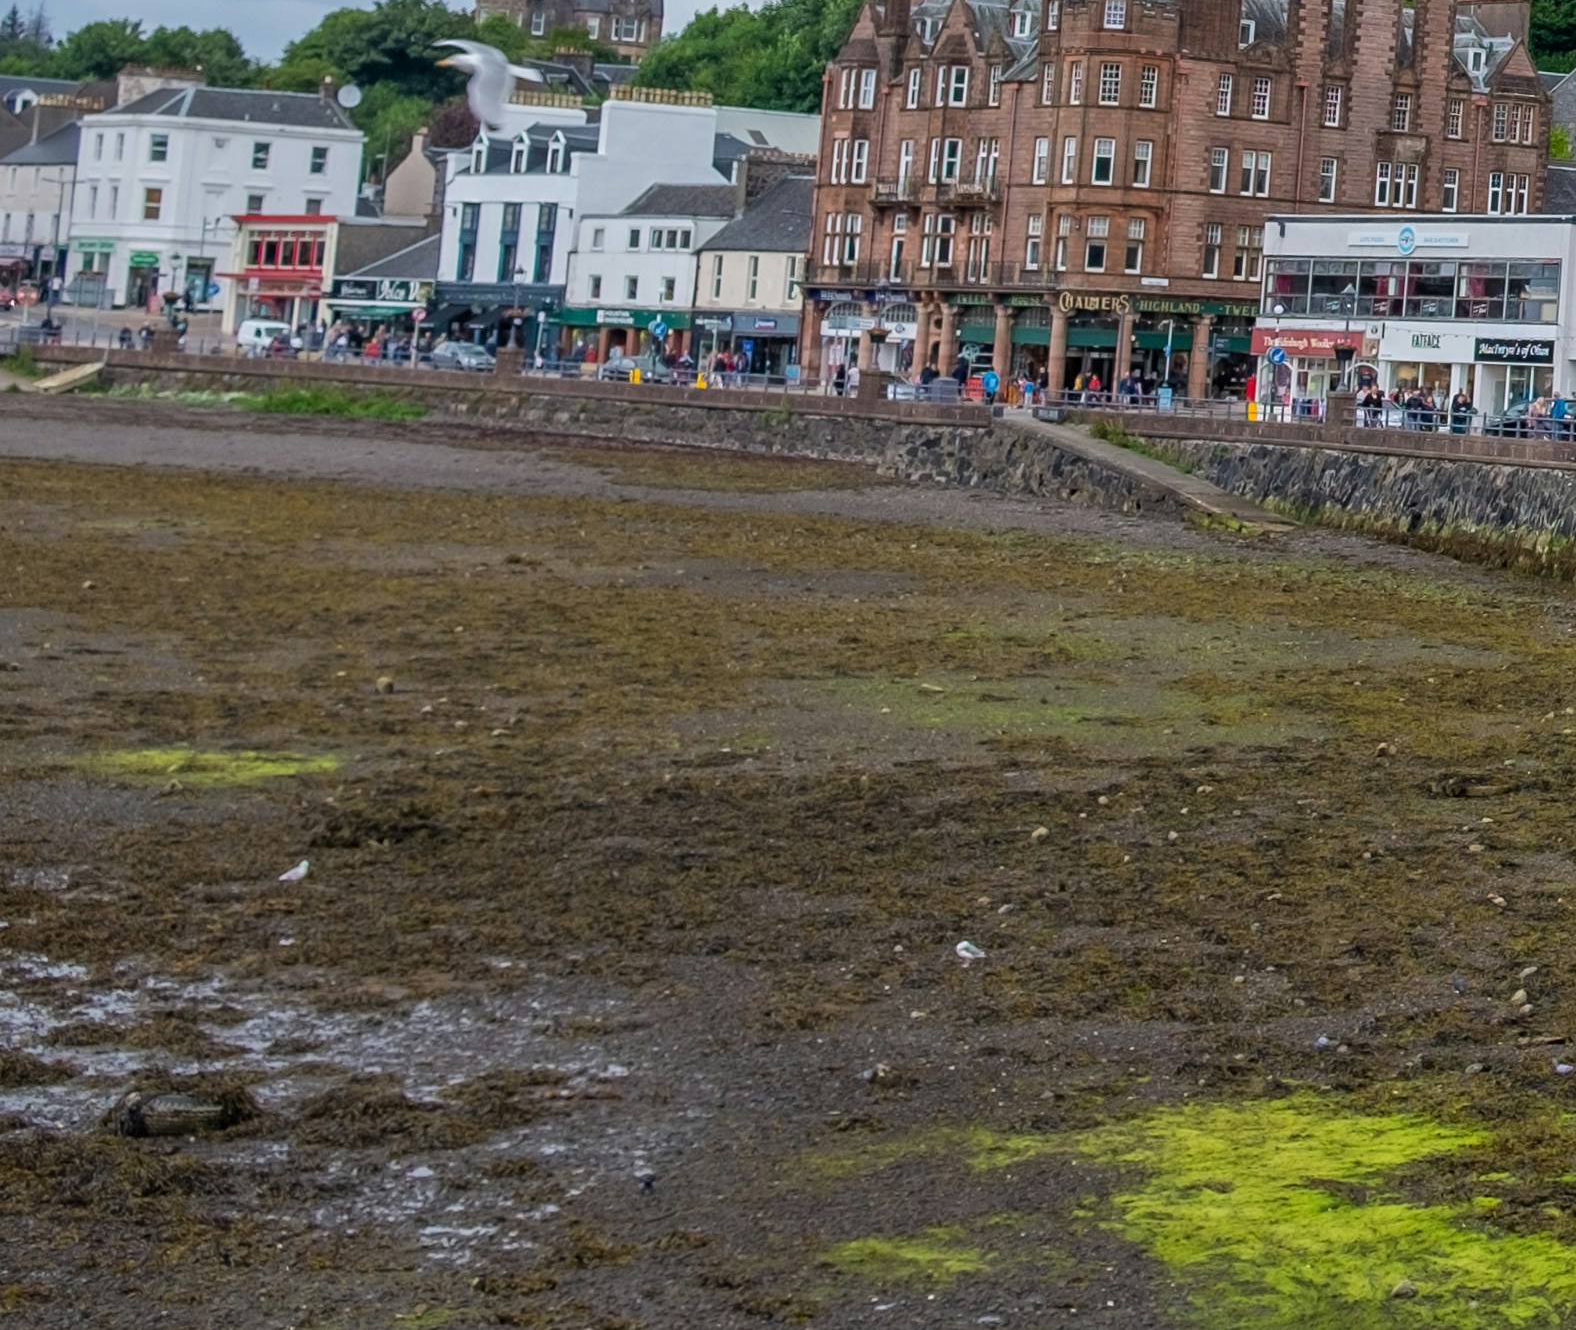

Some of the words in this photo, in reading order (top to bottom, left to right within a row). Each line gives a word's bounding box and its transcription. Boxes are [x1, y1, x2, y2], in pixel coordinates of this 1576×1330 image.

[957, 294, 987, 304] TWEED
[1058, 291, 1130, 314] CHALMERS
[1138, 299, 1200, 313] HIGHLAND
[1224, 304, 1259, 317] TWEE
